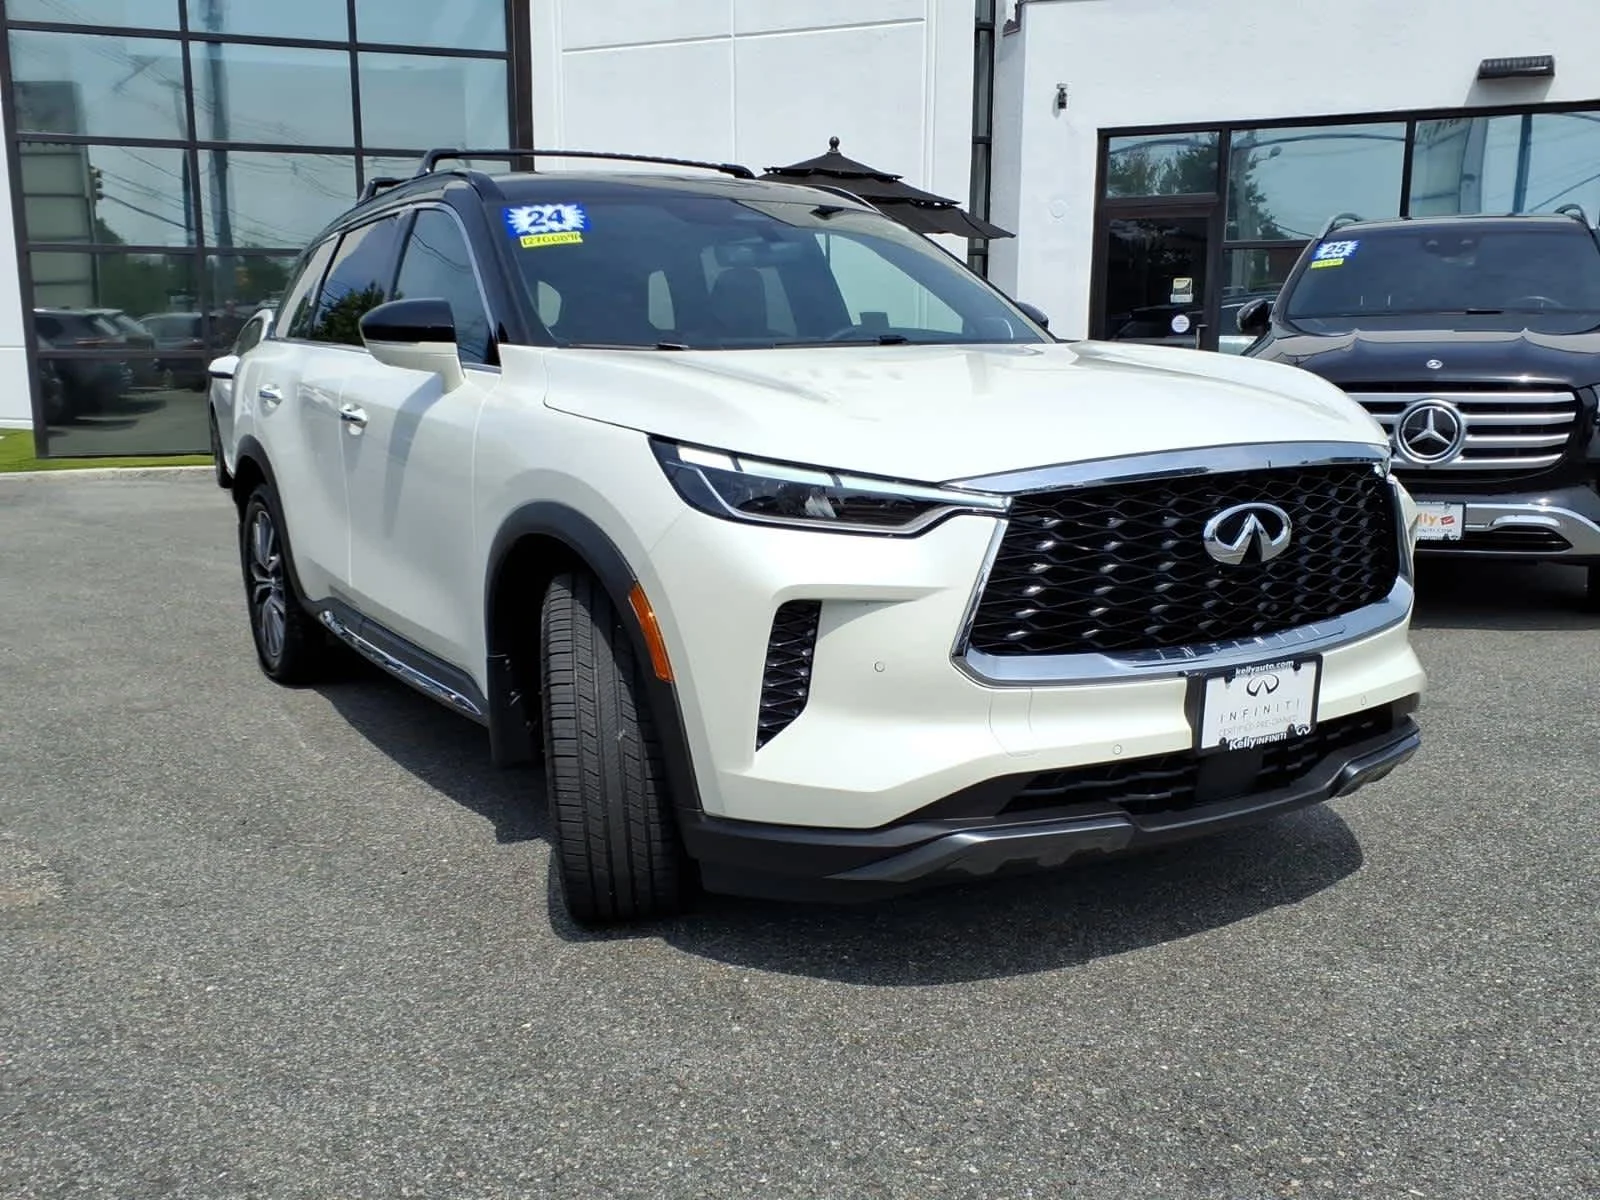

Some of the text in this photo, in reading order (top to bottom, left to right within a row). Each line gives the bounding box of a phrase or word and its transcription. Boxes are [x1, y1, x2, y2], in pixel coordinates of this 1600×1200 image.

[527, 209, 566, 227] 24
[1323, 243, 1348, 256] 25
[1235, 660, 1294, 677] kellyauto.com
[1220, 699, 1300, 724] INFINITI
